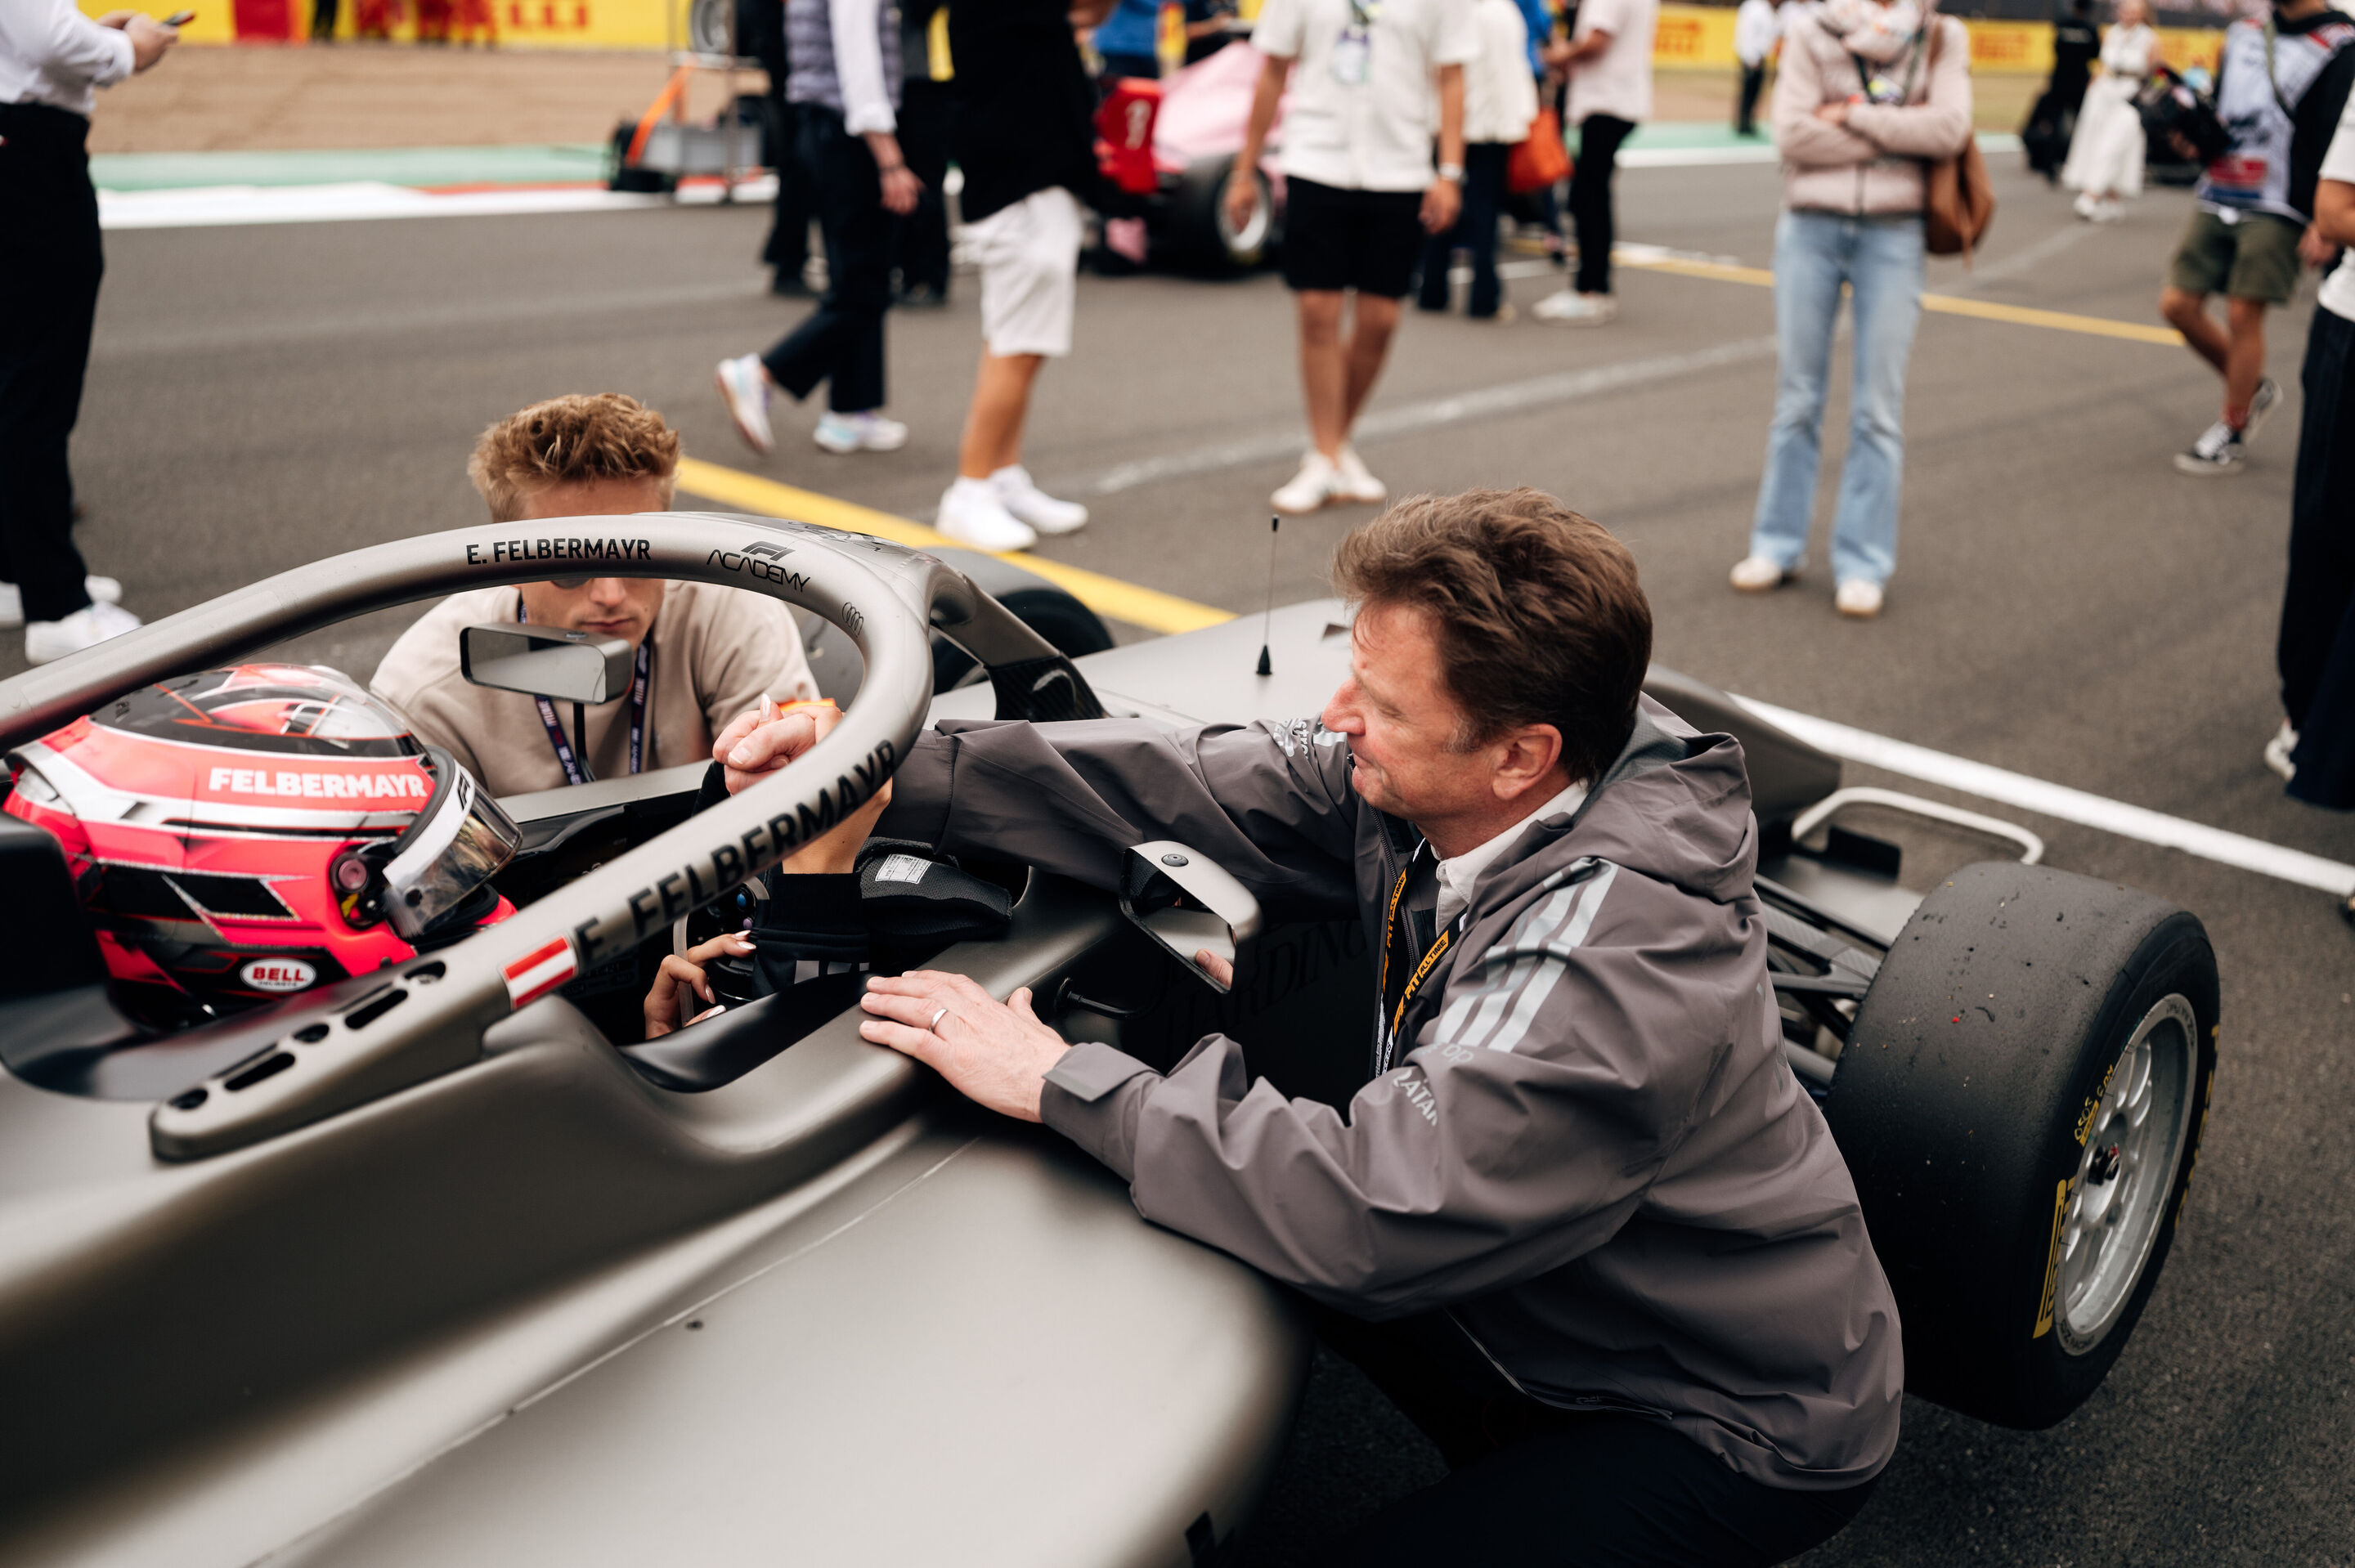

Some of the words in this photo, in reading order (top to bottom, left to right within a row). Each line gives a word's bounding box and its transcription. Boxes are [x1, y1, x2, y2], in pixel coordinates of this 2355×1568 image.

[466, 544, 487, 566] E.
[493, 538, 652, 564] FELBERMAYR
[741, 540, 796, 562] F1
[706, 549, 811, 593] ACADEMY
[209, 768, 427, 797] FELBERMAYR
[628, 739, 897, 939] FELBERMAYR
[1428, 939, 1447, 959] TIME
[253, 966, 305, 982] BELL
